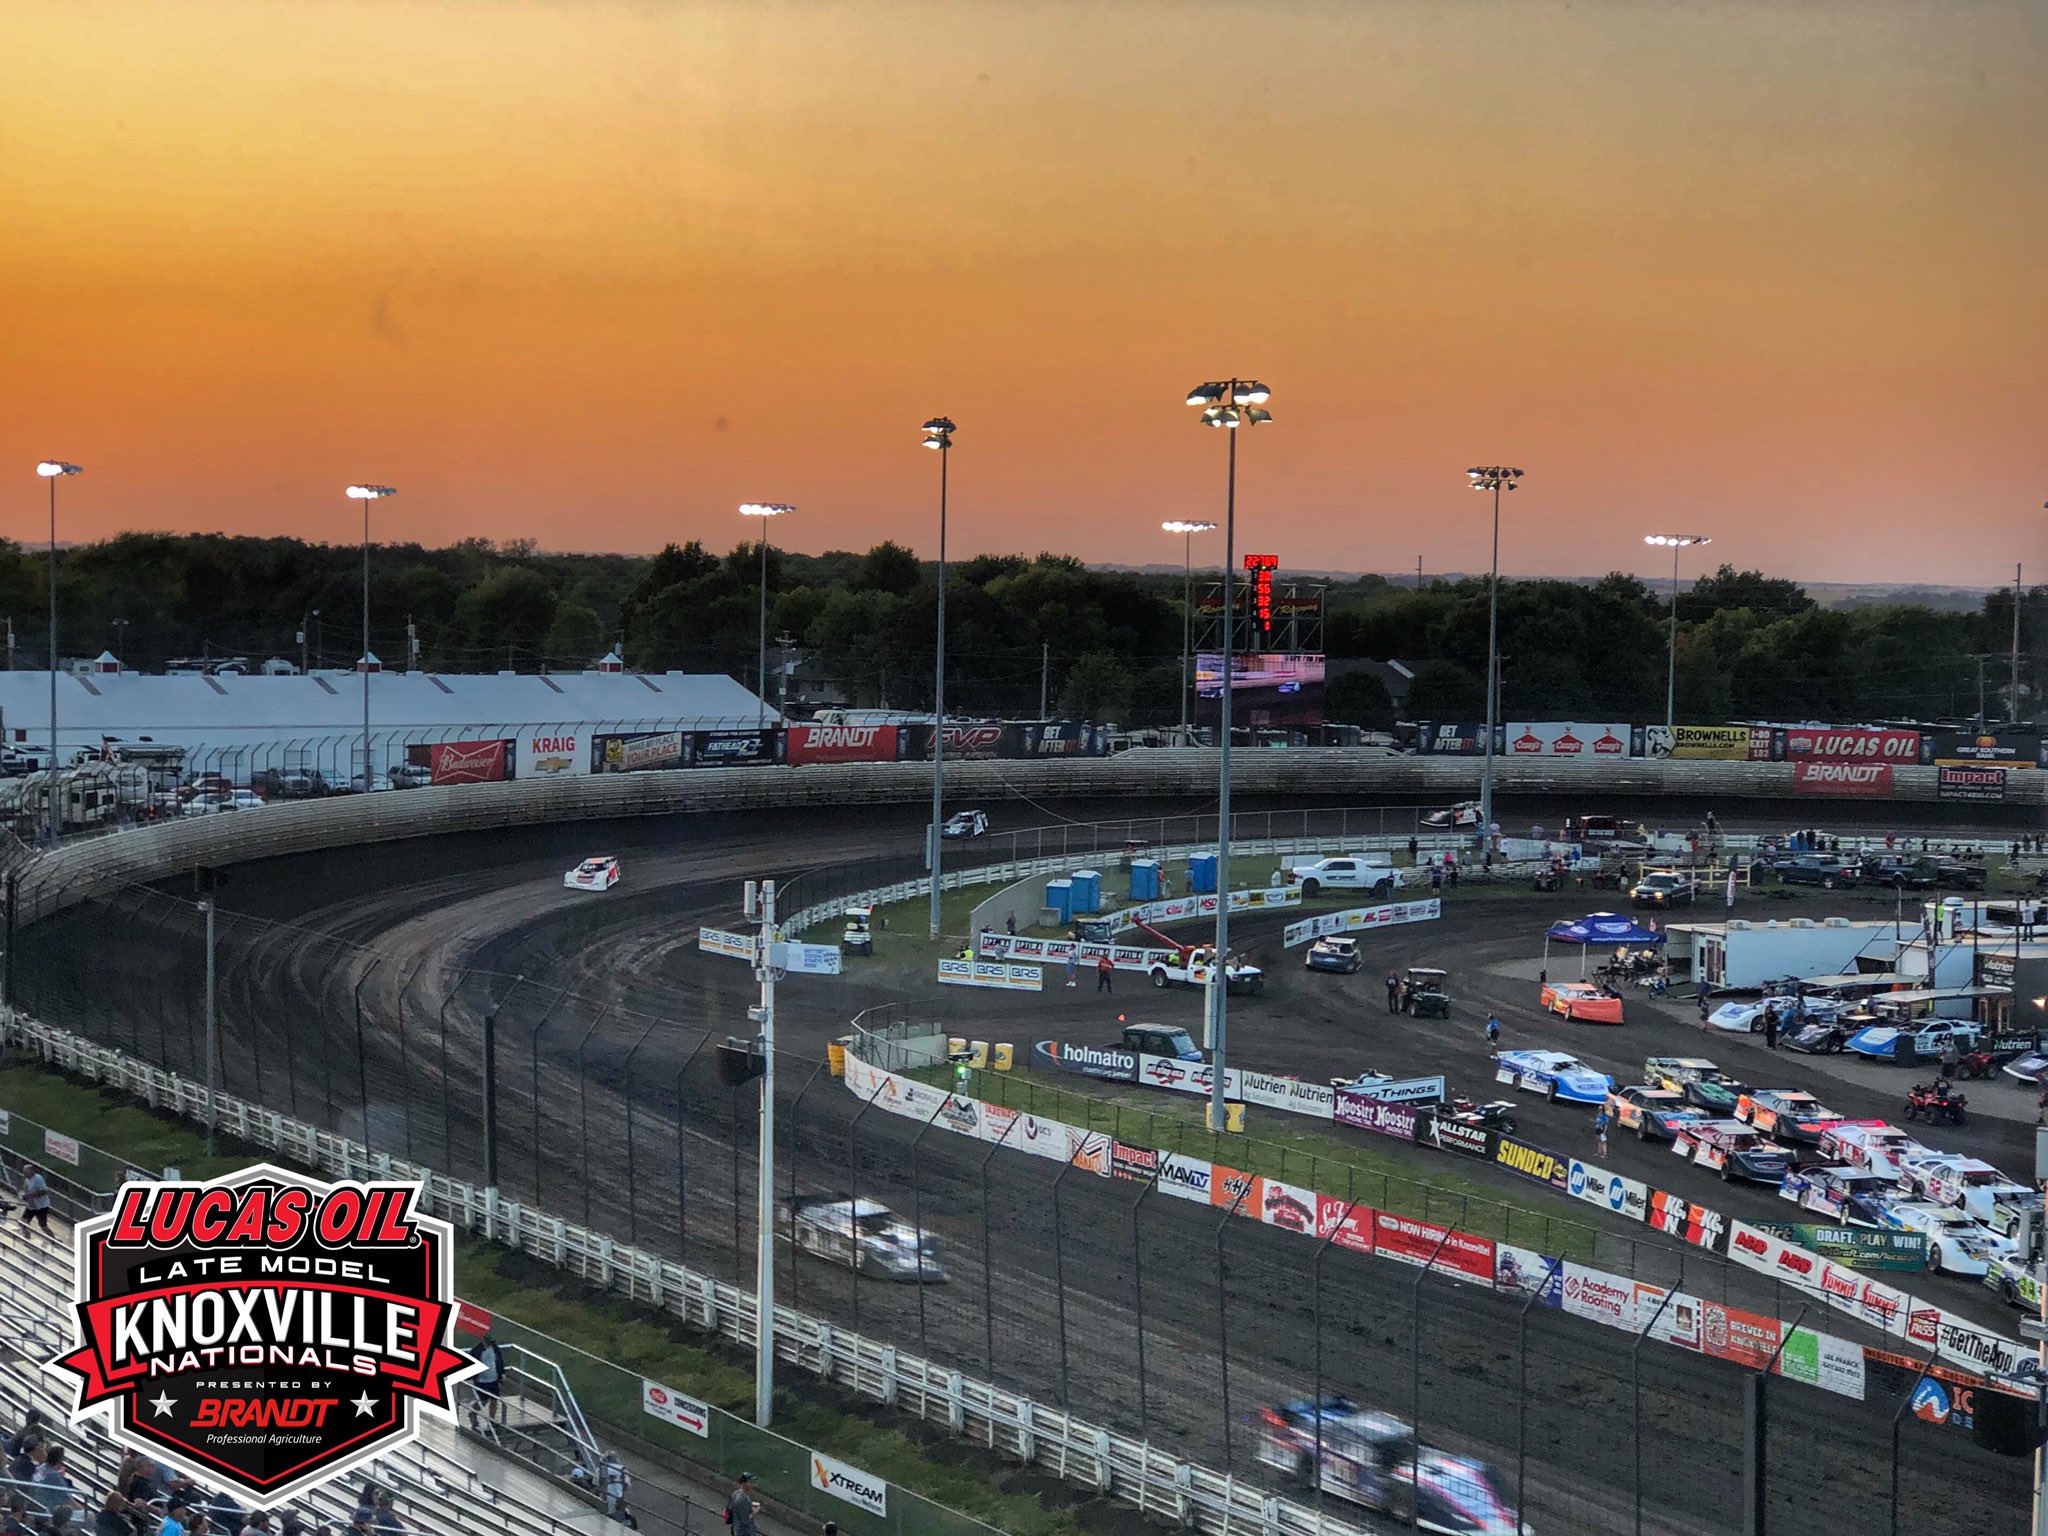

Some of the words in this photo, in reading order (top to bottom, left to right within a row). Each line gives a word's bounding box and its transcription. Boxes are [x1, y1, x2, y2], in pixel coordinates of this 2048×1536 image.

[804, 728, 880, 748] BRANDT
[1044, 726, 1062, 739] GET
[1439, 725, 1458, 737] GET
[1676, 728, 1746, 741] BROWNELLS
[532, 736, 575, 753] KRAIG
[1038, 740, 1066, 752] AFTER
[1433, 738, 1463, 750] AFTER
[1813, 736, 1879, 757] LUCAS
[1883, 738, 1915, 757] OIL
[439, 754, 495, 772] Budweiser
[1802, 765, 1885, 783] BRANDT
[1941, 769, 2004, 786] Impact
[942, 962, 969, 973] BRS
[977, 965, 1004, 976] BRS
[1011, 968, 1039, 979] BRS
[1994, 1039, 2032, 1050] Nutrien
[1064, 1043, 1135, 1069] holmatro
[1244, 1073, 1286, 1095] Nutrien
[1290, 1082, 1334, 1104] Nutrien
[1380, 1085, 1436, 1099] THINGS
[1335, 1094, 1375, 1120] Hoosier
[1374, 1105, 1416, 1130] Hoosier
[1439, 1121, 1487, 1142] ALLSTAR
[1113, 1140, 1157, 1170] Impact
[1496, 1140, 1554, 1180] SUNOCO
[1586, 1176, 1606, 1195] Miller
[1625, 1189, 1645, 1210] Miller
[1400, 1221, 1421, 1236] NOW
[1816, 1229, 1856, 1245] DRAFT.
[1893, 1235, 1921, 1250] WIN!
[1581, 1276, 1629, 1304] Academy
[1581, 1291, 1621, 1317] Roofing
[1730, 1320, 1764, 1338] BREWED
[1765, 1329, 1777, 1341] IN
[1910, 1322, 1936, 1337] PASS
[1939, 1327, 2013, 1374] #GetTheApp
[829, 1471, 883, 1504] XTREAM
